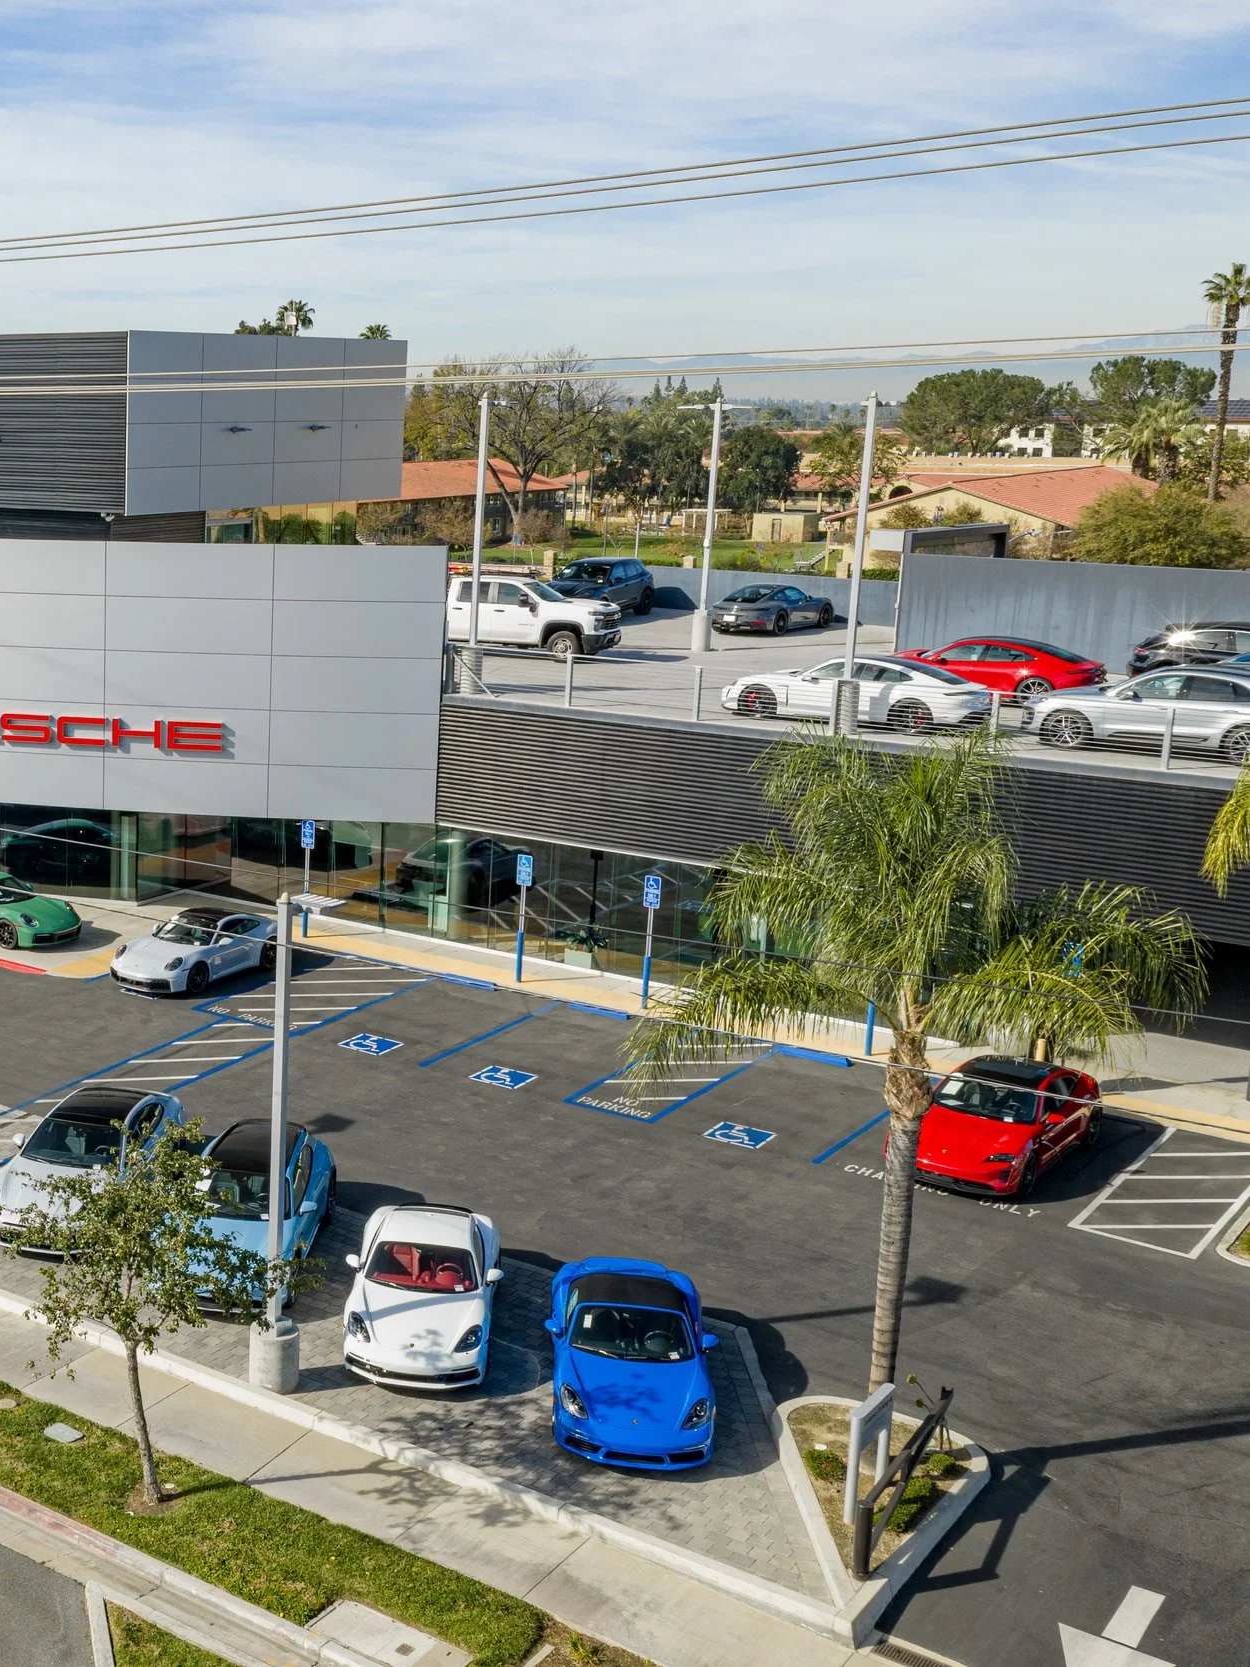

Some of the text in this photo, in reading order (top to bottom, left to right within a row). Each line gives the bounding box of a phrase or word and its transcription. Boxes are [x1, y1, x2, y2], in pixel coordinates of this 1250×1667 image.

[207, 1006, 230, 1014] NO
[576, 1096, 652, 1119] PARKING
[612, 1096, 639, 1106] NO
[979, 1200, 1041, 1217] ONLY
